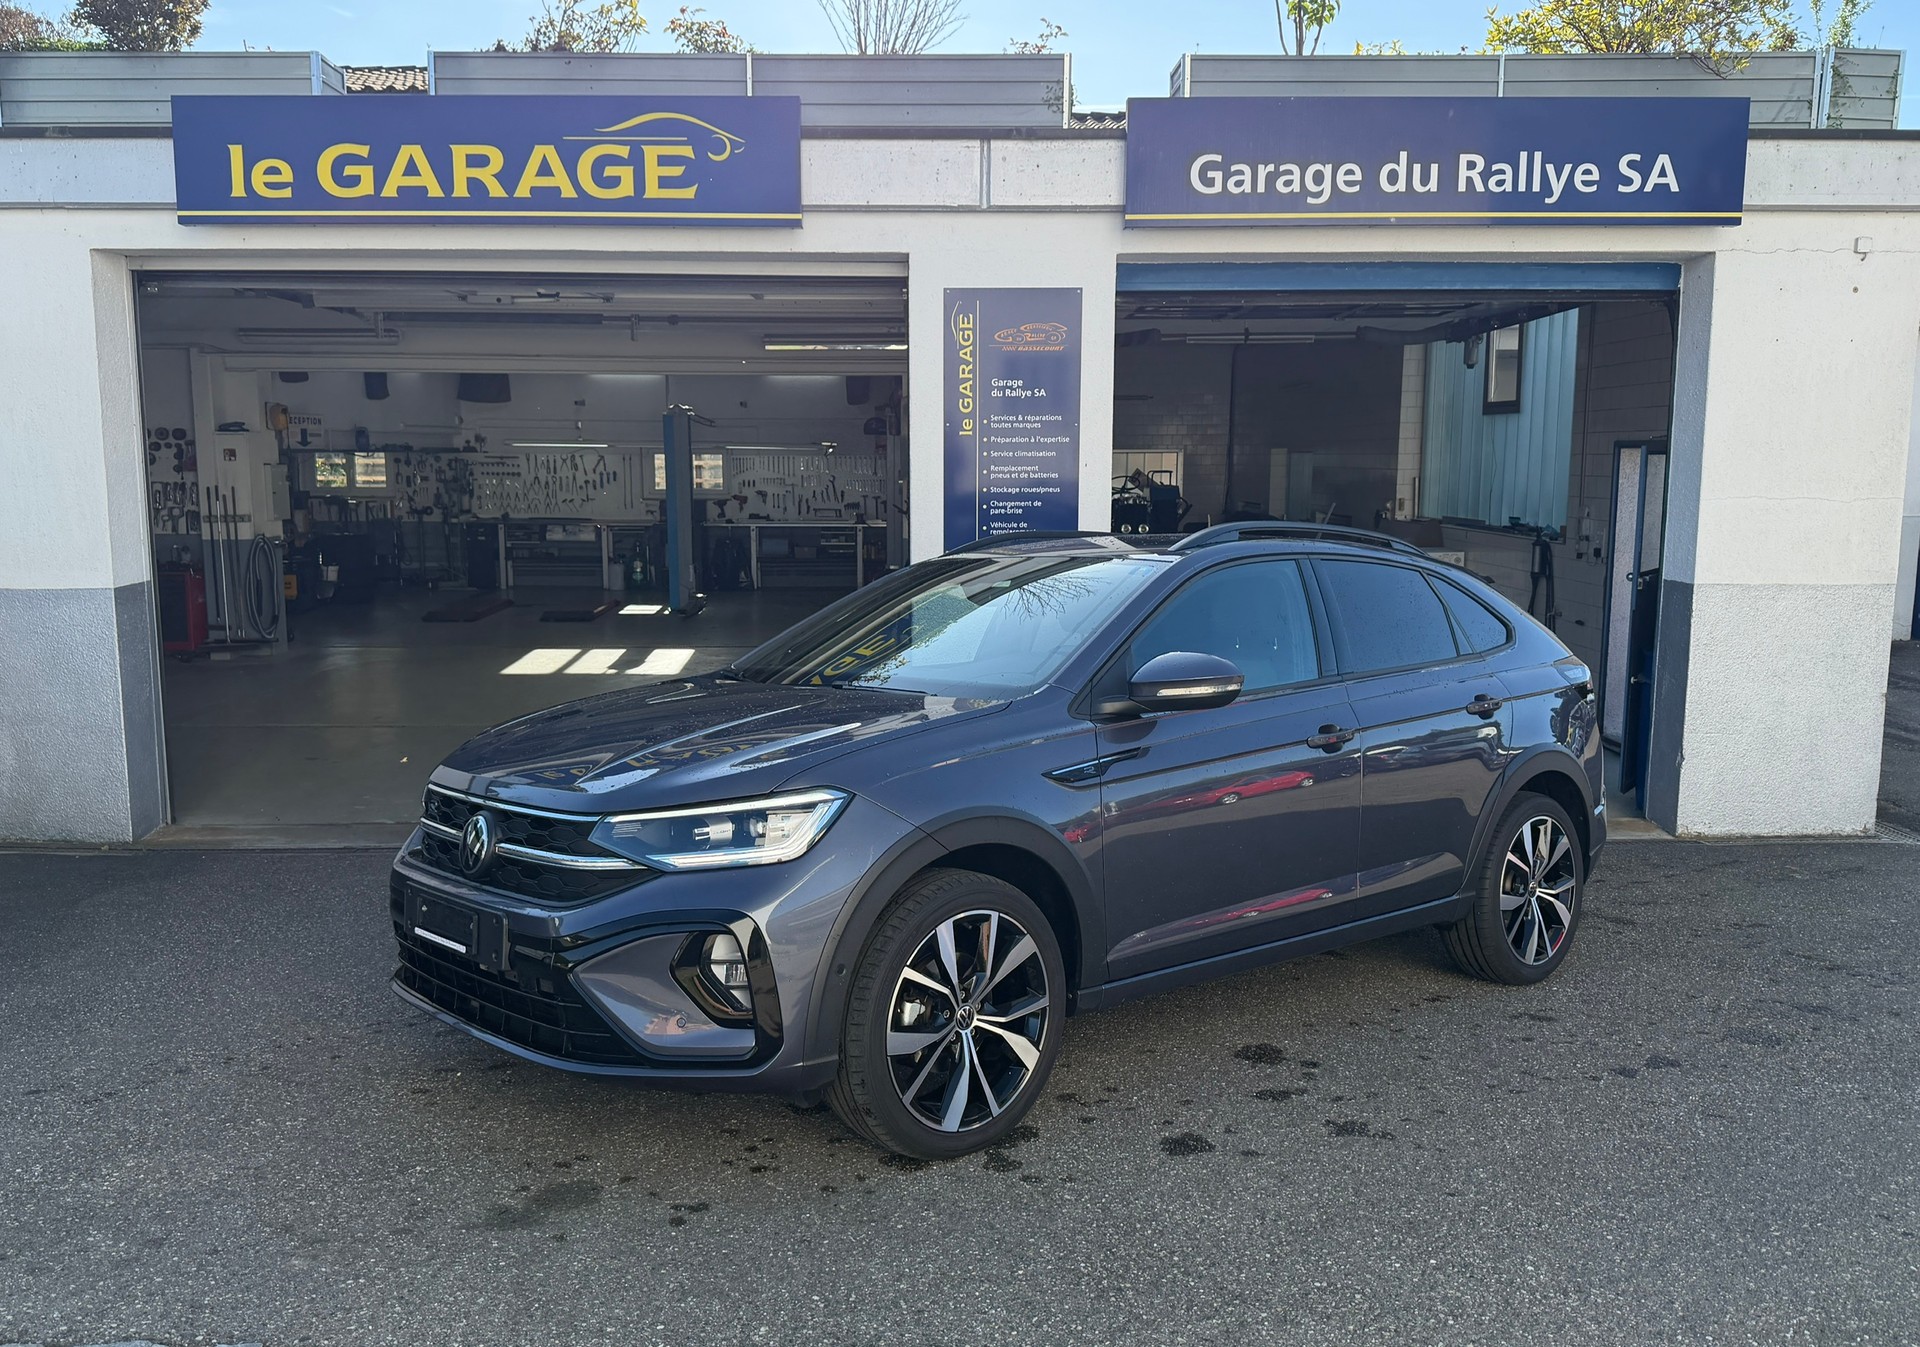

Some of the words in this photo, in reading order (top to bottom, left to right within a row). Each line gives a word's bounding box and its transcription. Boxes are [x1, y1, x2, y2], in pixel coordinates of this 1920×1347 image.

[227, 143, 294, 199] le
[316, 143, 698, 199] GARAGE
[1190, 153, 1363, 204] Garage
[1379, 151, 1439, 194] du
[1458, 151, 1600, 204] Rallye
[1618, 153, 1680, 194] SA
[959, 313, 973, 413] GARAGE
[991, 378, 1023, 388] Garage
[991, 388, 1003, 397] du
[1005, 388, 1032, 399] Rallye
[1034, 388, 1047, 397] SA
[289, 416, 322, 425] ECEPTION
[1024, 414, 1062, 422] réparations
[959, 418, 973, 435] le
[990, 436, 1029, 444] Préparation
[1036, 436, 1070, 444] l'expertise
[990, 486, 1020, 494] Stockage
[1021, 486, 1061, 494] roues/pneus
[990, 500, 1032, 508] Changement
[990, 507, 1023, 515] pare-brise
